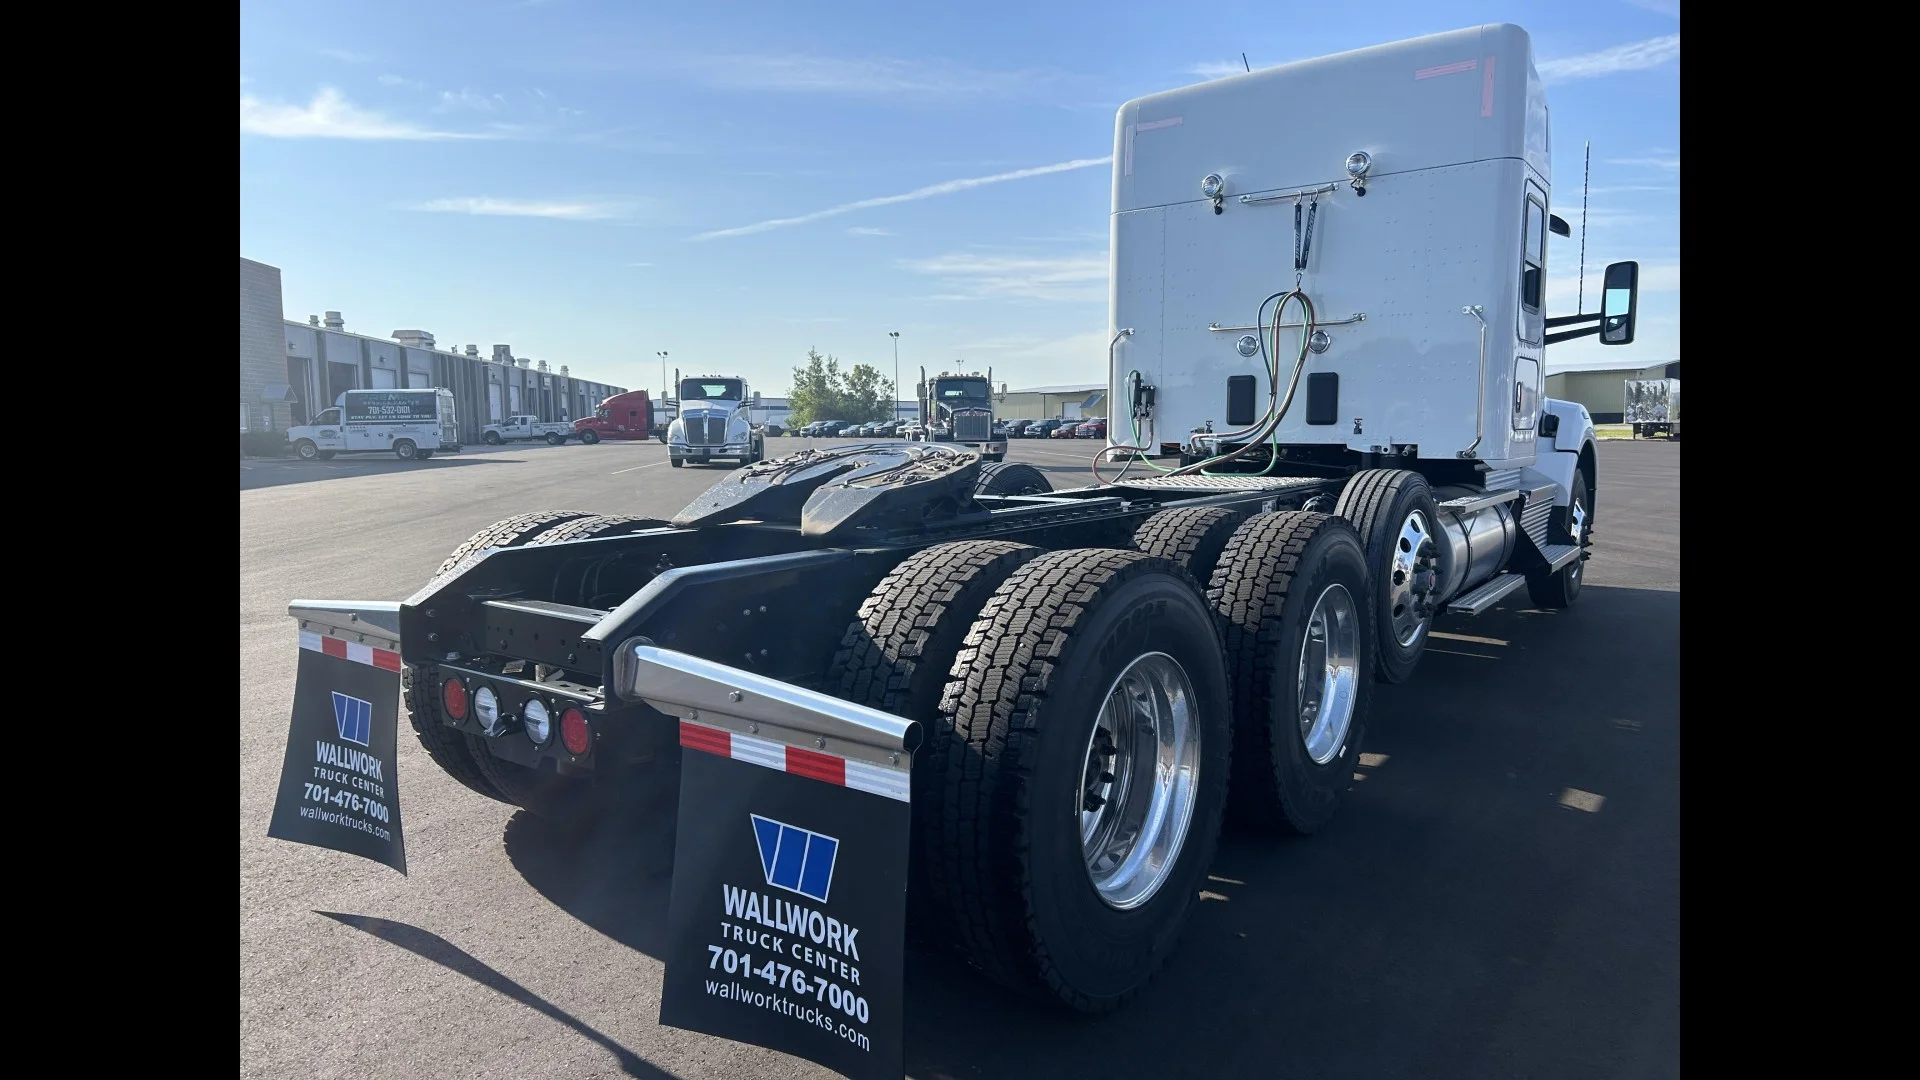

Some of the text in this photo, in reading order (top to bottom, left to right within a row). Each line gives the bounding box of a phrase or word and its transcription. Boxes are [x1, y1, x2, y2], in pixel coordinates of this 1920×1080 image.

[368, 406, 411, 414] 701-532-0101
[314, 767, 384, 798] TRUCK CENTER
[317, 741, 383, 783] WALLWORK
[300, 806, 391, 841] wallworktrucks.com
[304, 783, 389, 823] 701-476-7000
[723, 884, 859, 961] WALLWORK
[721, 922, 860, 986] TRUCK CENTER
[708, 945, 869, 1024] 701-476-7000
[705, 979, 870, 1052] wallworktrucks.com
